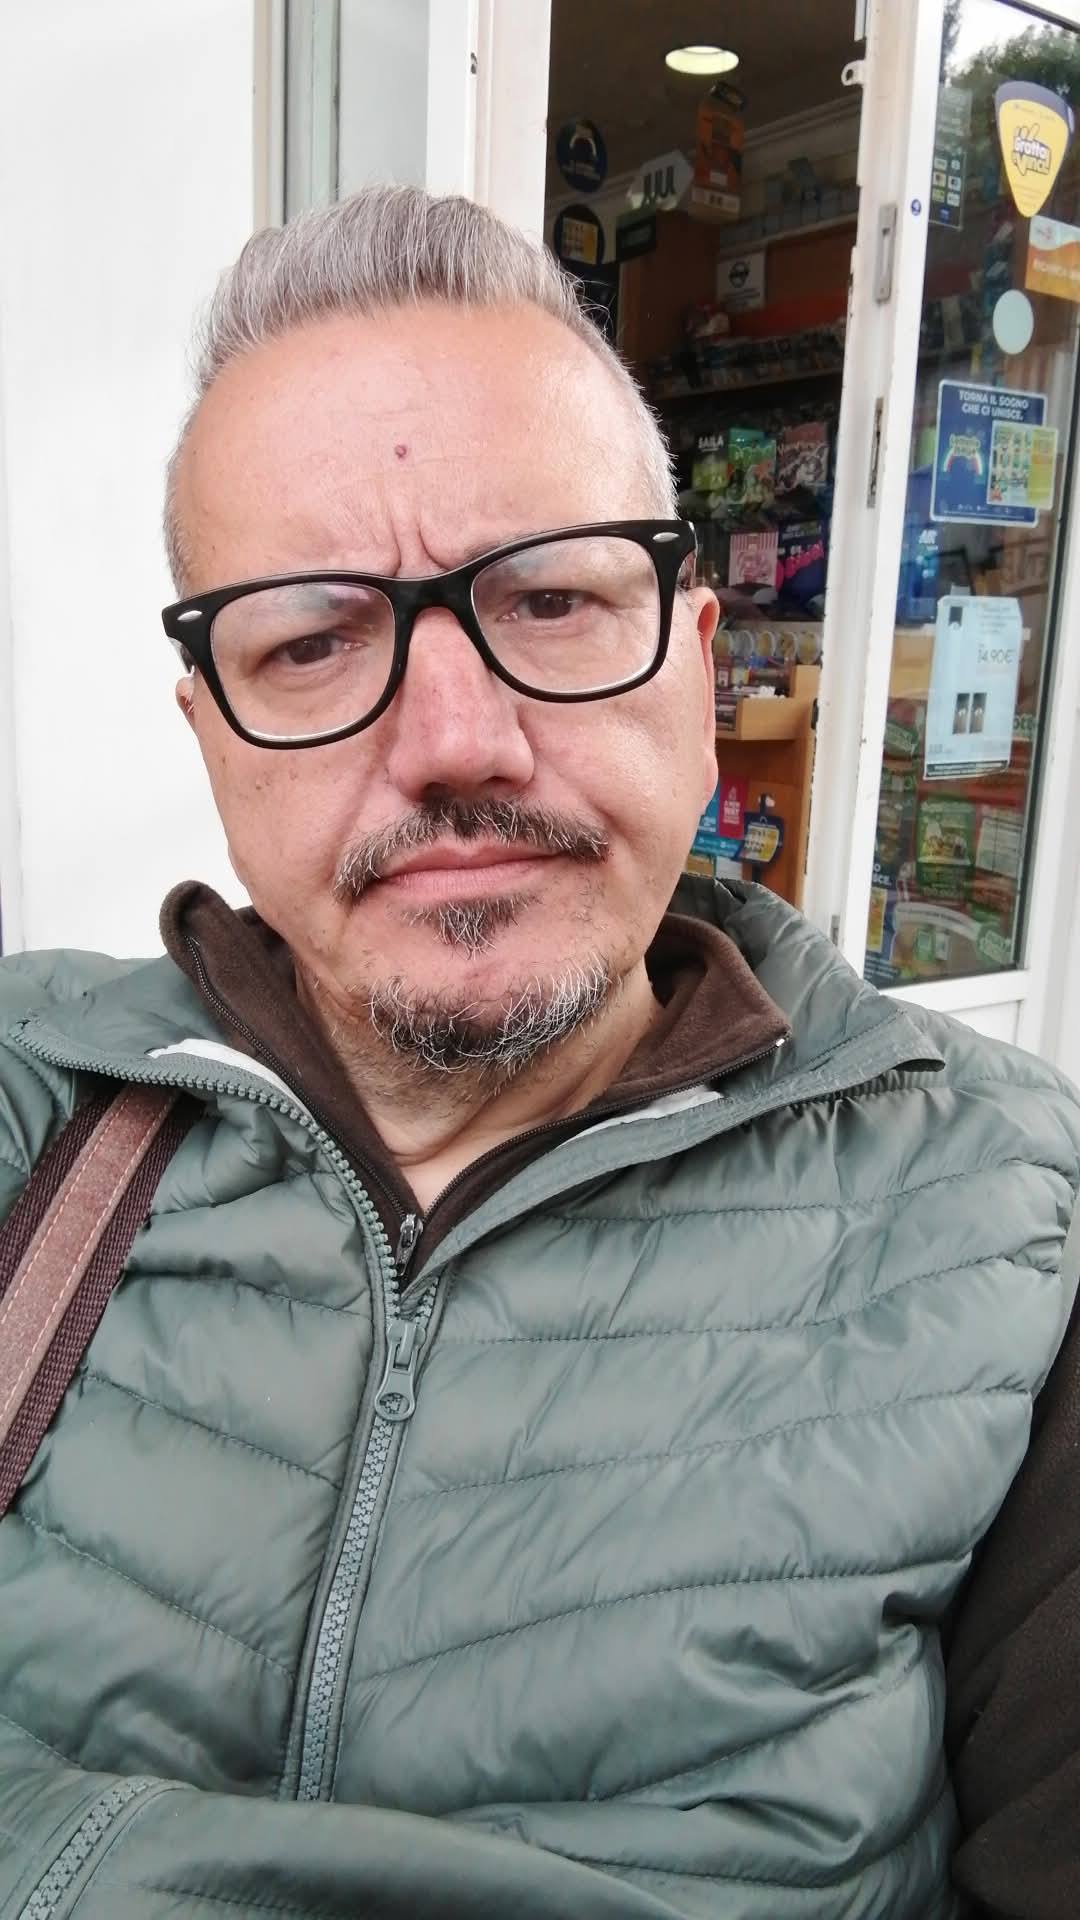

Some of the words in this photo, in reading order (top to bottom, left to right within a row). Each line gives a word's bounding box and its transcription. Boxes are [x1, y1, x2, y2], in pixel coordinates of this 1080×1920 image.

[959, 389, 989, 404] TORNA
[989, 394, 998, 406] IL
[998, 394, 1030, 410] SOGNO
[961, 402, 980, 415] CHE
[980, 405, 992, 416] CI
